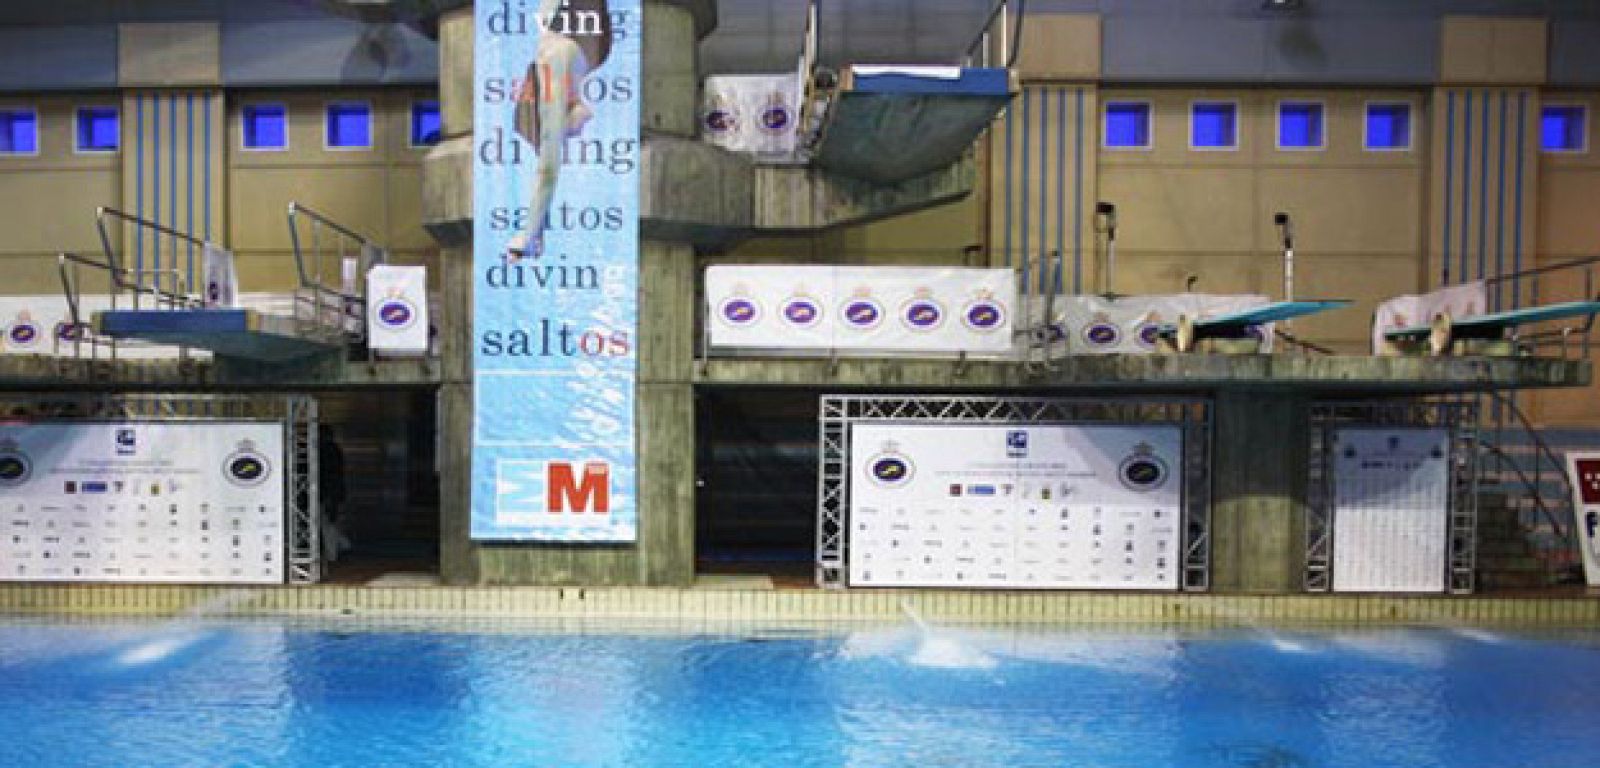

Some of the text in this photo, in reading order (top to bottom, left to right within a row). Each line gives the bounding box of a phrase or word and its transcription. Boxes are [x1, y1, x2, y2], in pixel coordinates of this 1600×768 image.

[479, 127, 637, 174] diing
[480, 318, 629, 357] saltos
[547, 462, 610, 513] M
